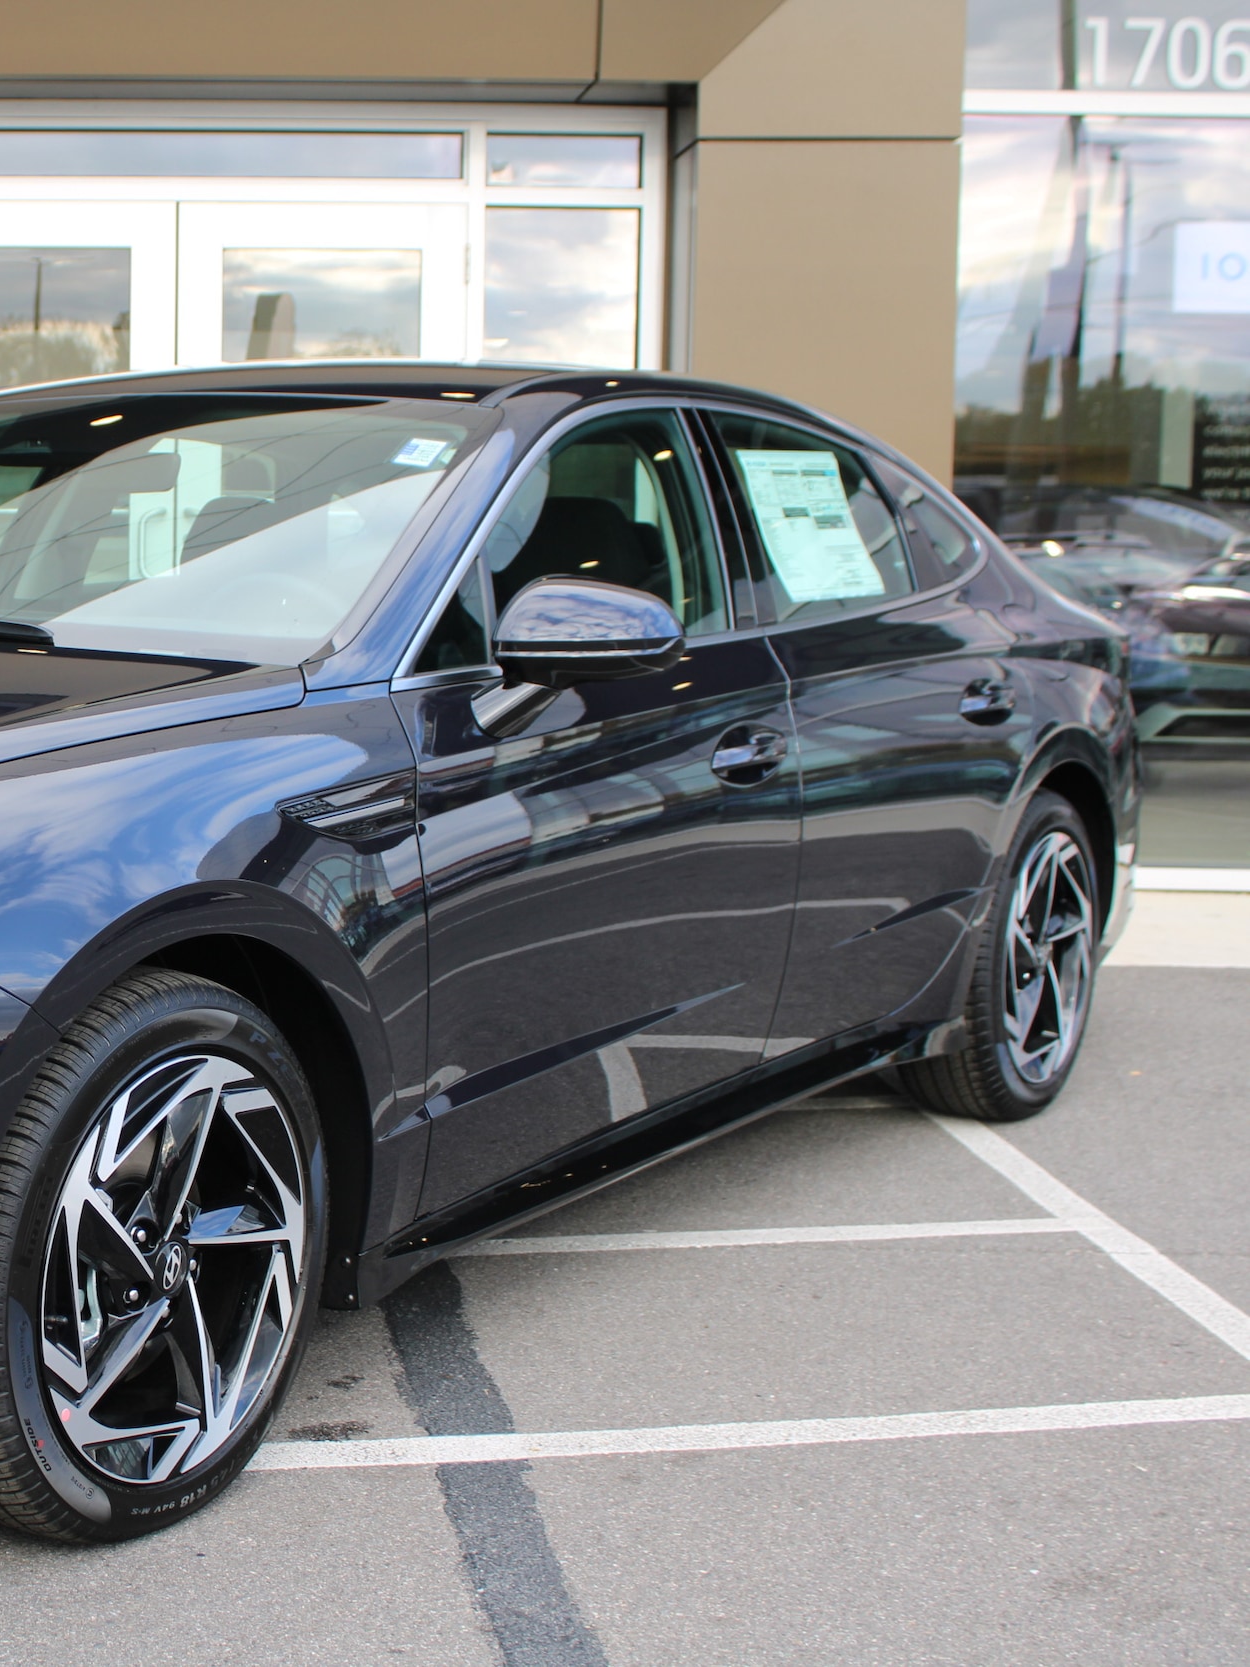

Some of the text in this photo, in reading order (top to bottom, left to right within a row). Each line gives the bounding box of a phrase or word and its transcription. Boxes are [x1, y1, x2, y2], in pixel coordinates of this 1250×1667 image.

[1085, 16, 1250, 89] 1706
[23, 1418, 52, 1473] OUTSIDE
[179, 1484, 207, 1508] R18
